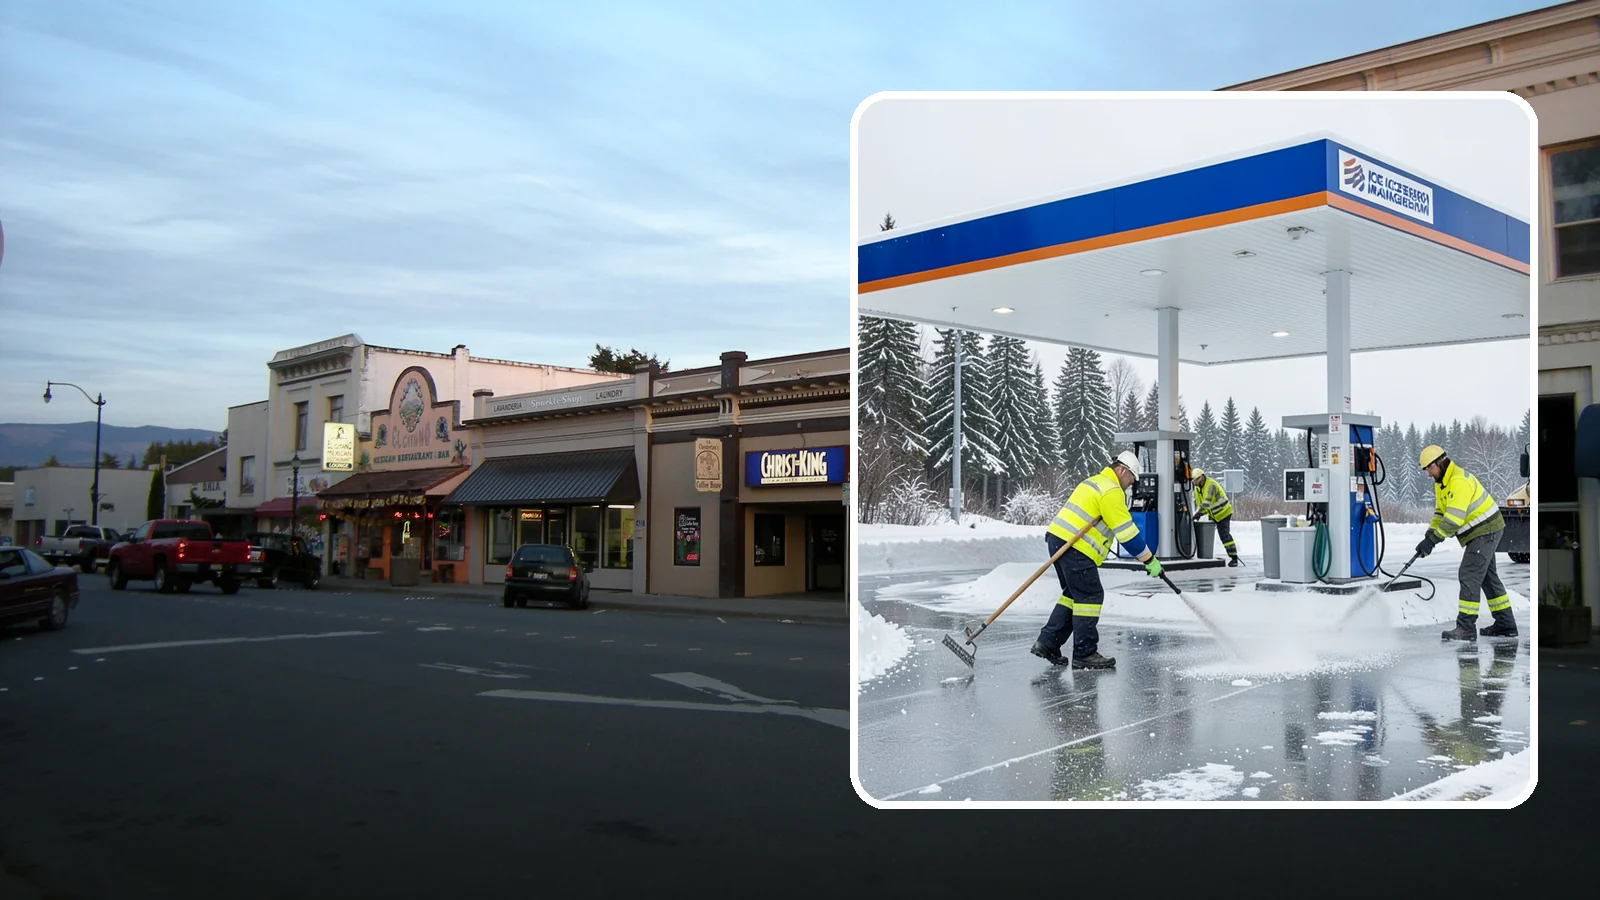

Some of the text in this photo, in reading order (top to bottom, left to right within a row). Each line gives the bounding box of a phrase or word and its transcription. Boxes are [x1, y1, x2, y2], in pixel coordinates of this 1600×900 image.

[493, 402, 523, 413] LAVANDERIA
[595, 389, 624, 400] LAUNDRY
[397, 452, 433, 462] RESTAURANT
[438, 450, 450, 459] BAR
[761, 450, 827, 478] CHRIST KING
